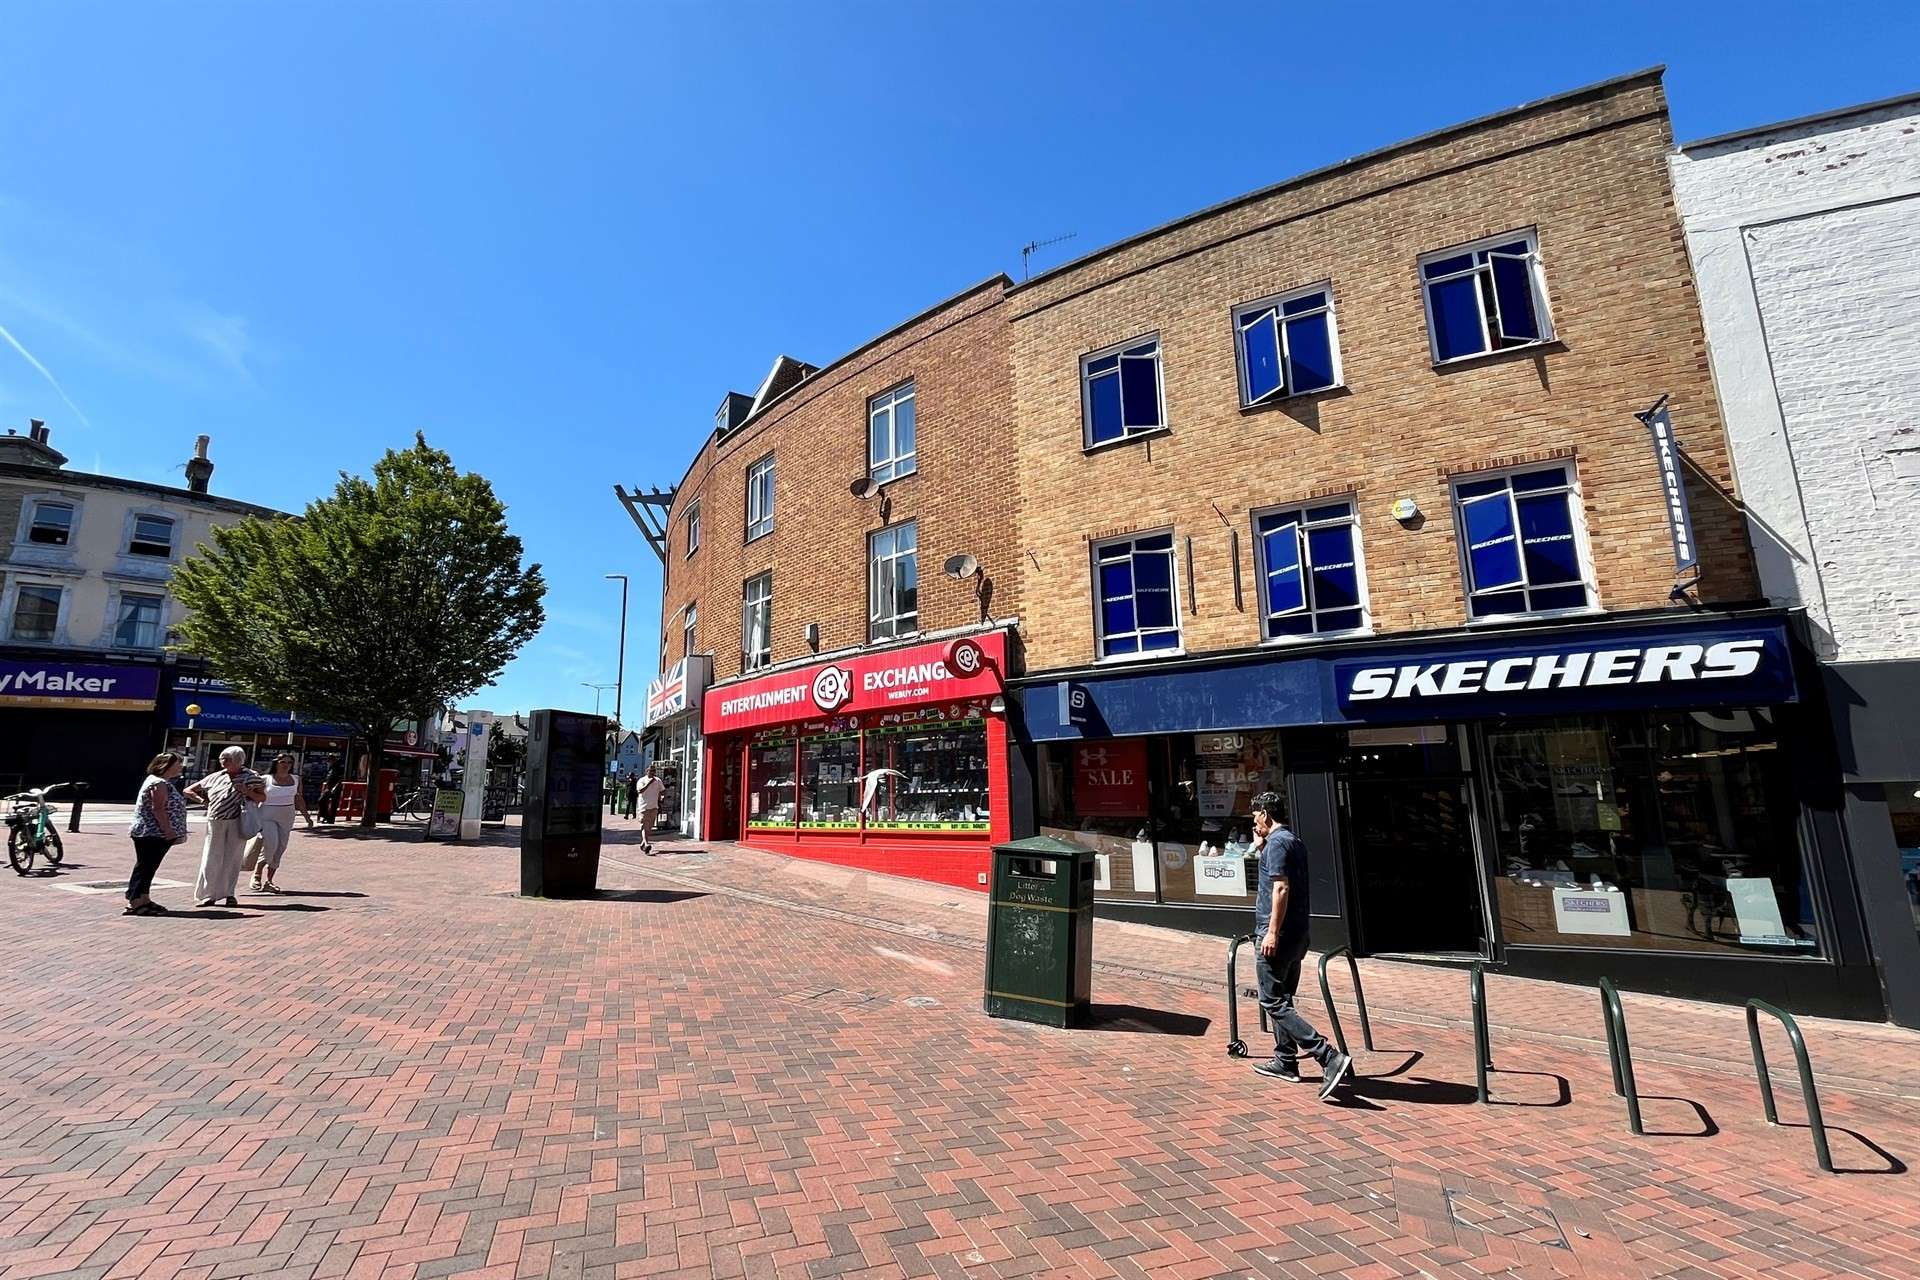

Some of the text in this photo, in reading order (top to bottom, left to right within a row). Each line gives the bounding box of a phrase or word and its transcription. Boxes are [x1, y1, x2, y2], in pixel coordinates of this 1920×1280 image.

[1655, 421, 1691, 561] SKECHERS
[1470, 534, 1515, 550] SKECHERS
[1524, 534, 1573, 545] SKECHERS
[1313, 561, 1354, 572] SKECHERS
[1348, 639, 1765, 701] SKECHERS
[721, 684, 807, 716] ENTERTAINMENT
[888, 687, 929, 700] WEBUY.COM
[1070, 690, 1086, 709] S
[199, 712, 226, 720] YOUR
[256, 715, 281, 723] YOUR
[1088, 769, 1134, 785] SALE
[1009, 891, 1053, 903] Dog Waste
